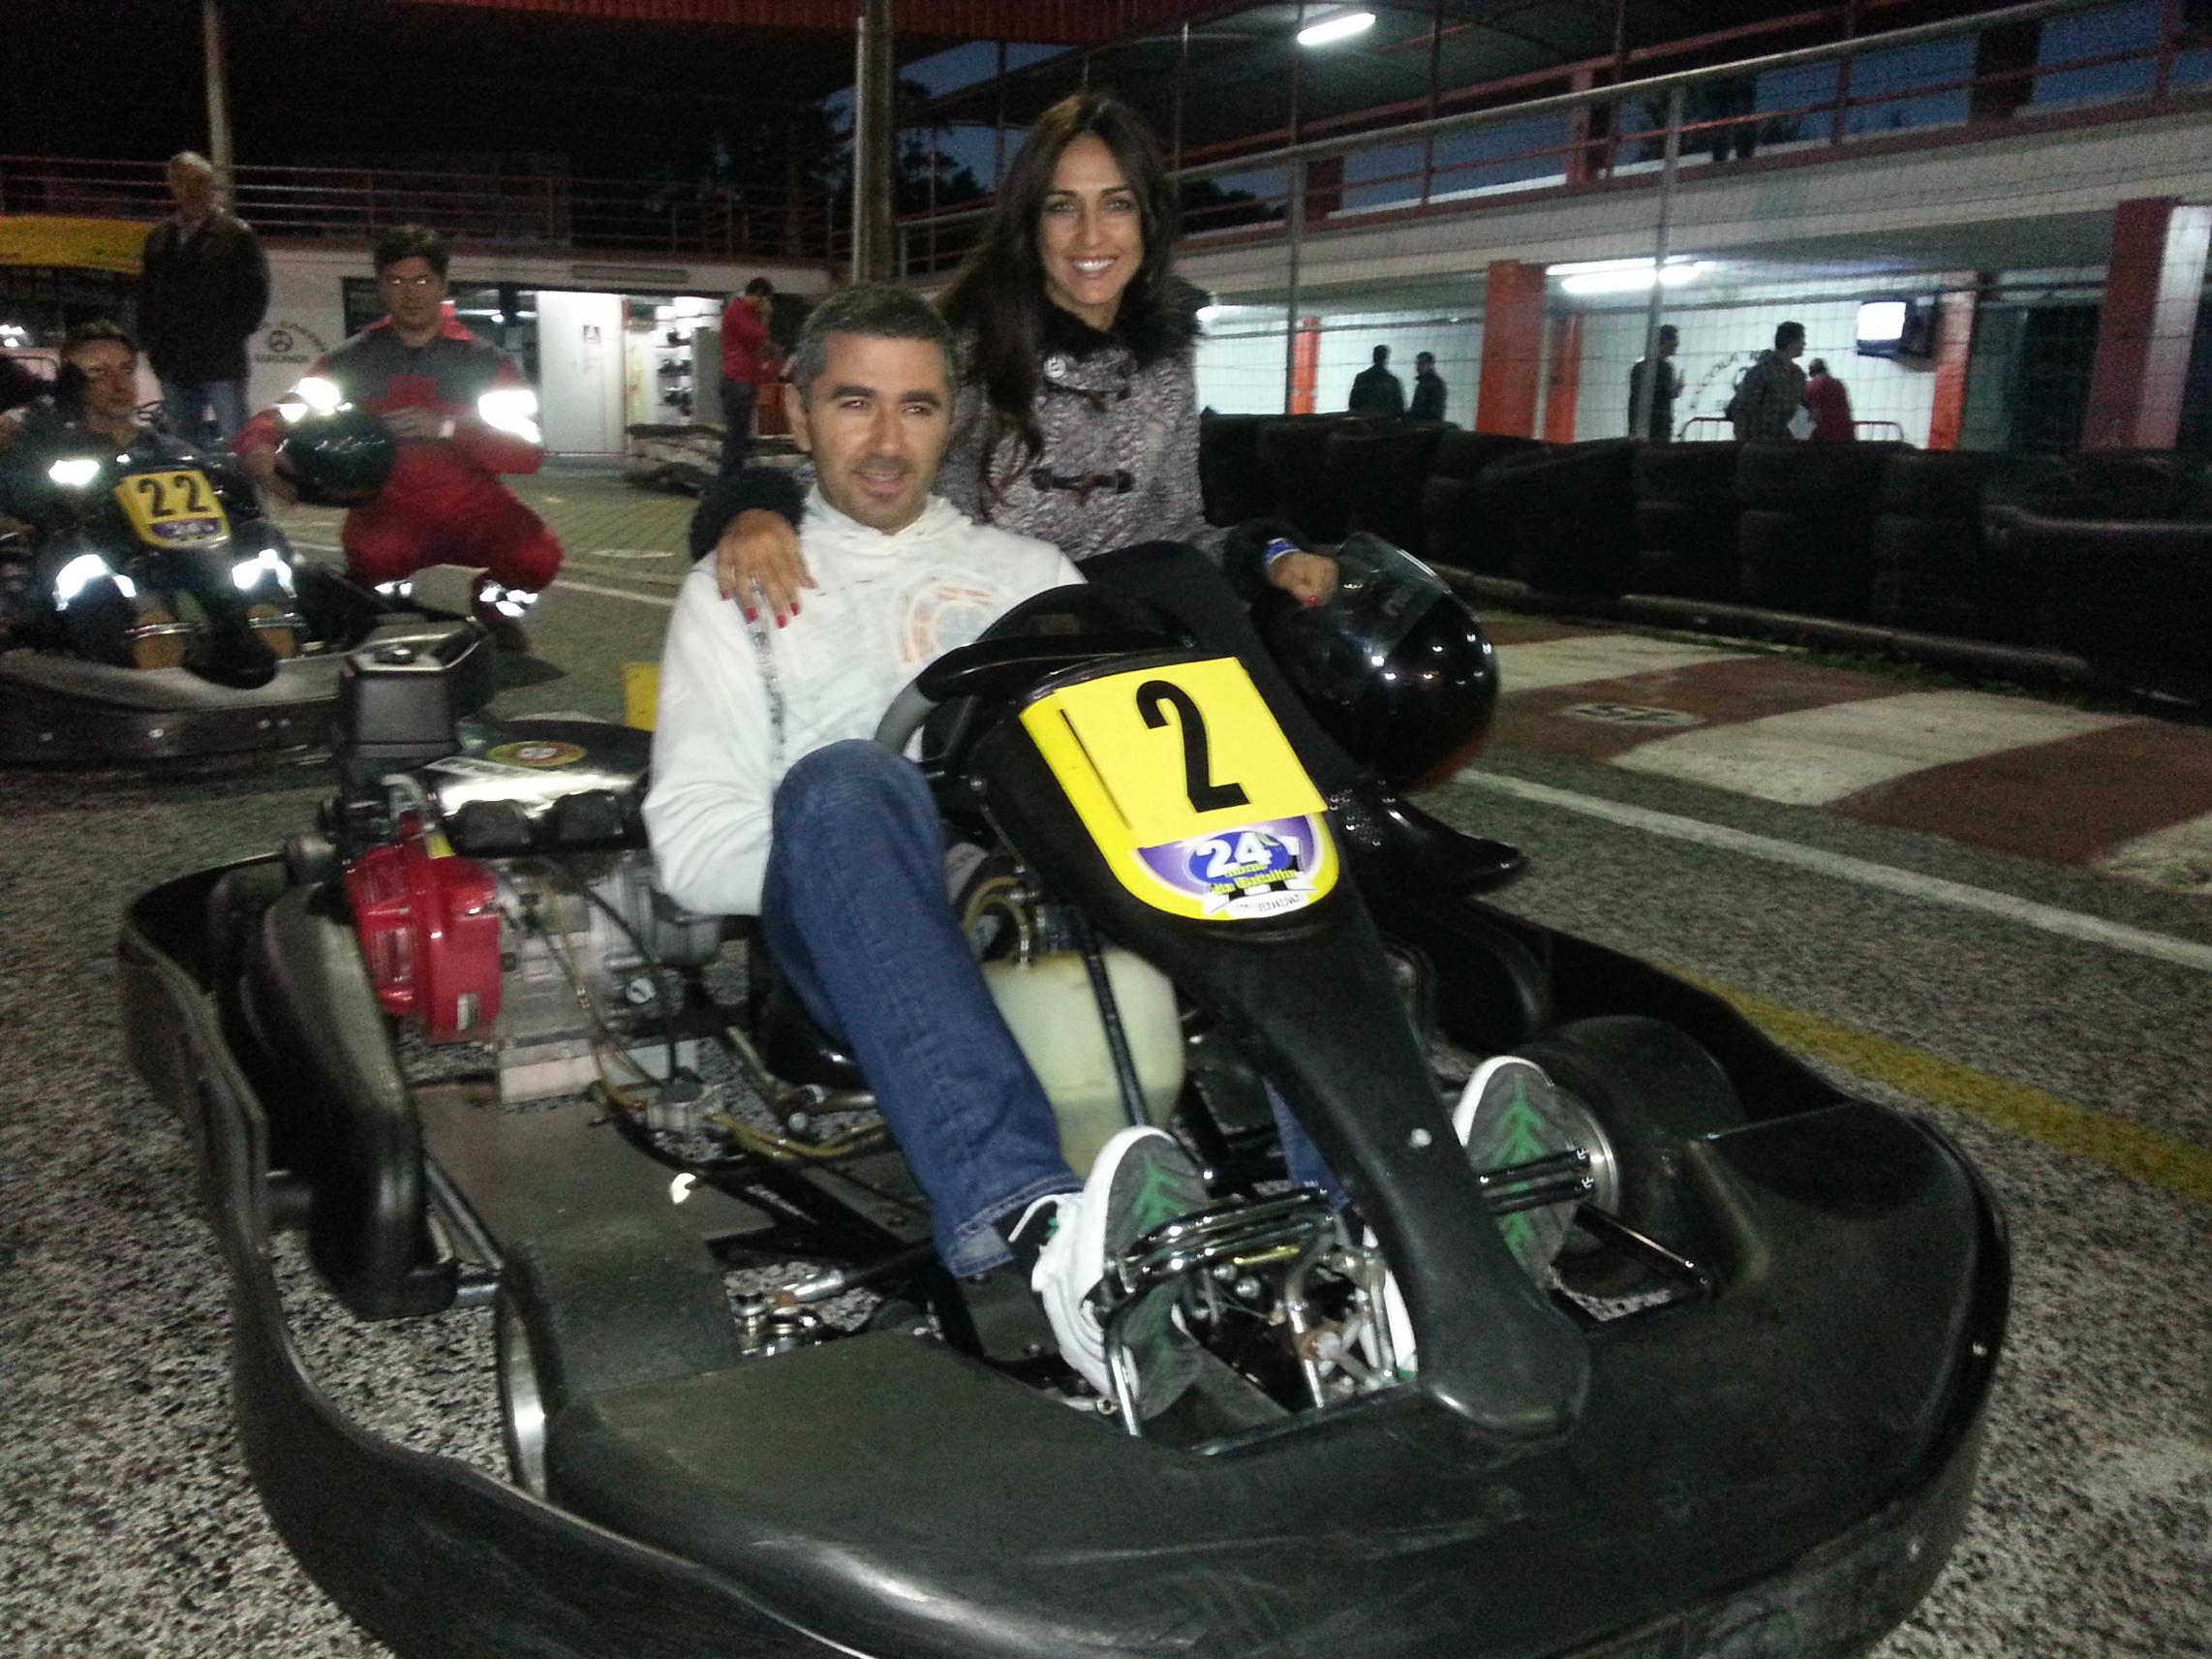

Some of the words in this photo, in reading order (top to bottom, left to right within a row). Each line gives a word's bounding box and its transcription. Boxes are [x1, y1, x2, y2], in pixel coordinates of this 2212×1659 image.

[138, 475, 210, 517] 22
[1136, 680, 1249, 813] 2
[1195, 831, 1273, 878] 24
